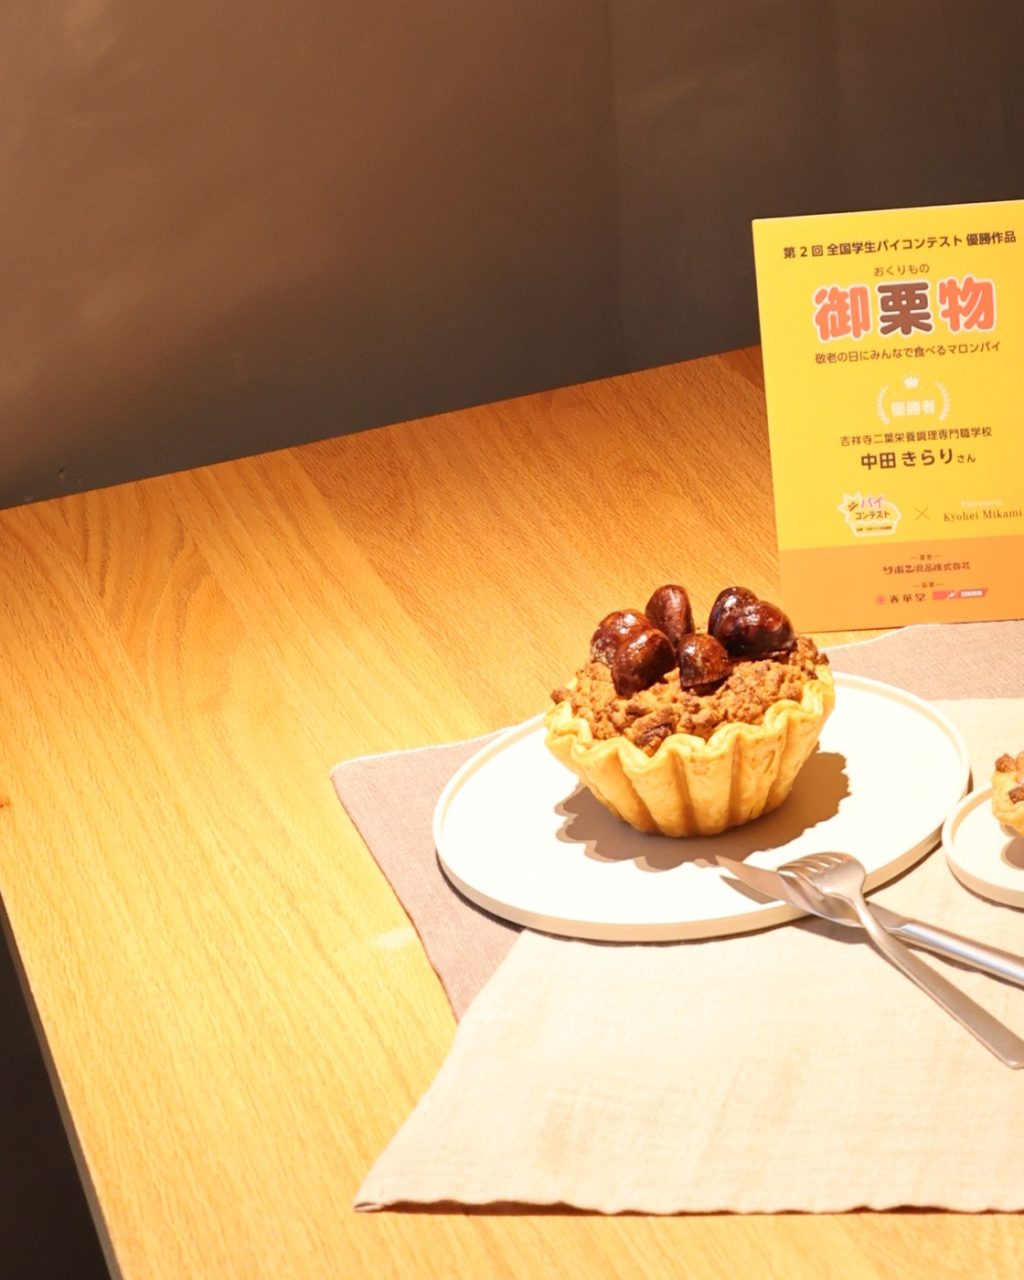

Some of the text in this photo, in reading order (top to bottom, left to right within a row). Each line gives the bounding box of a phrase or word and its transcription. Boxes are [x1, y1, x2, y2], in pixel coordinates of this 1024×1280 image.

[874, 263, 930, 277] おくりもの
[813, 275, 997, 341] 御栗物
[815, 341, 1001, 365] 敬老の日にみんなで食べるマロンパイ
[943, 508, 1023, 523] Kyohei Mikami
